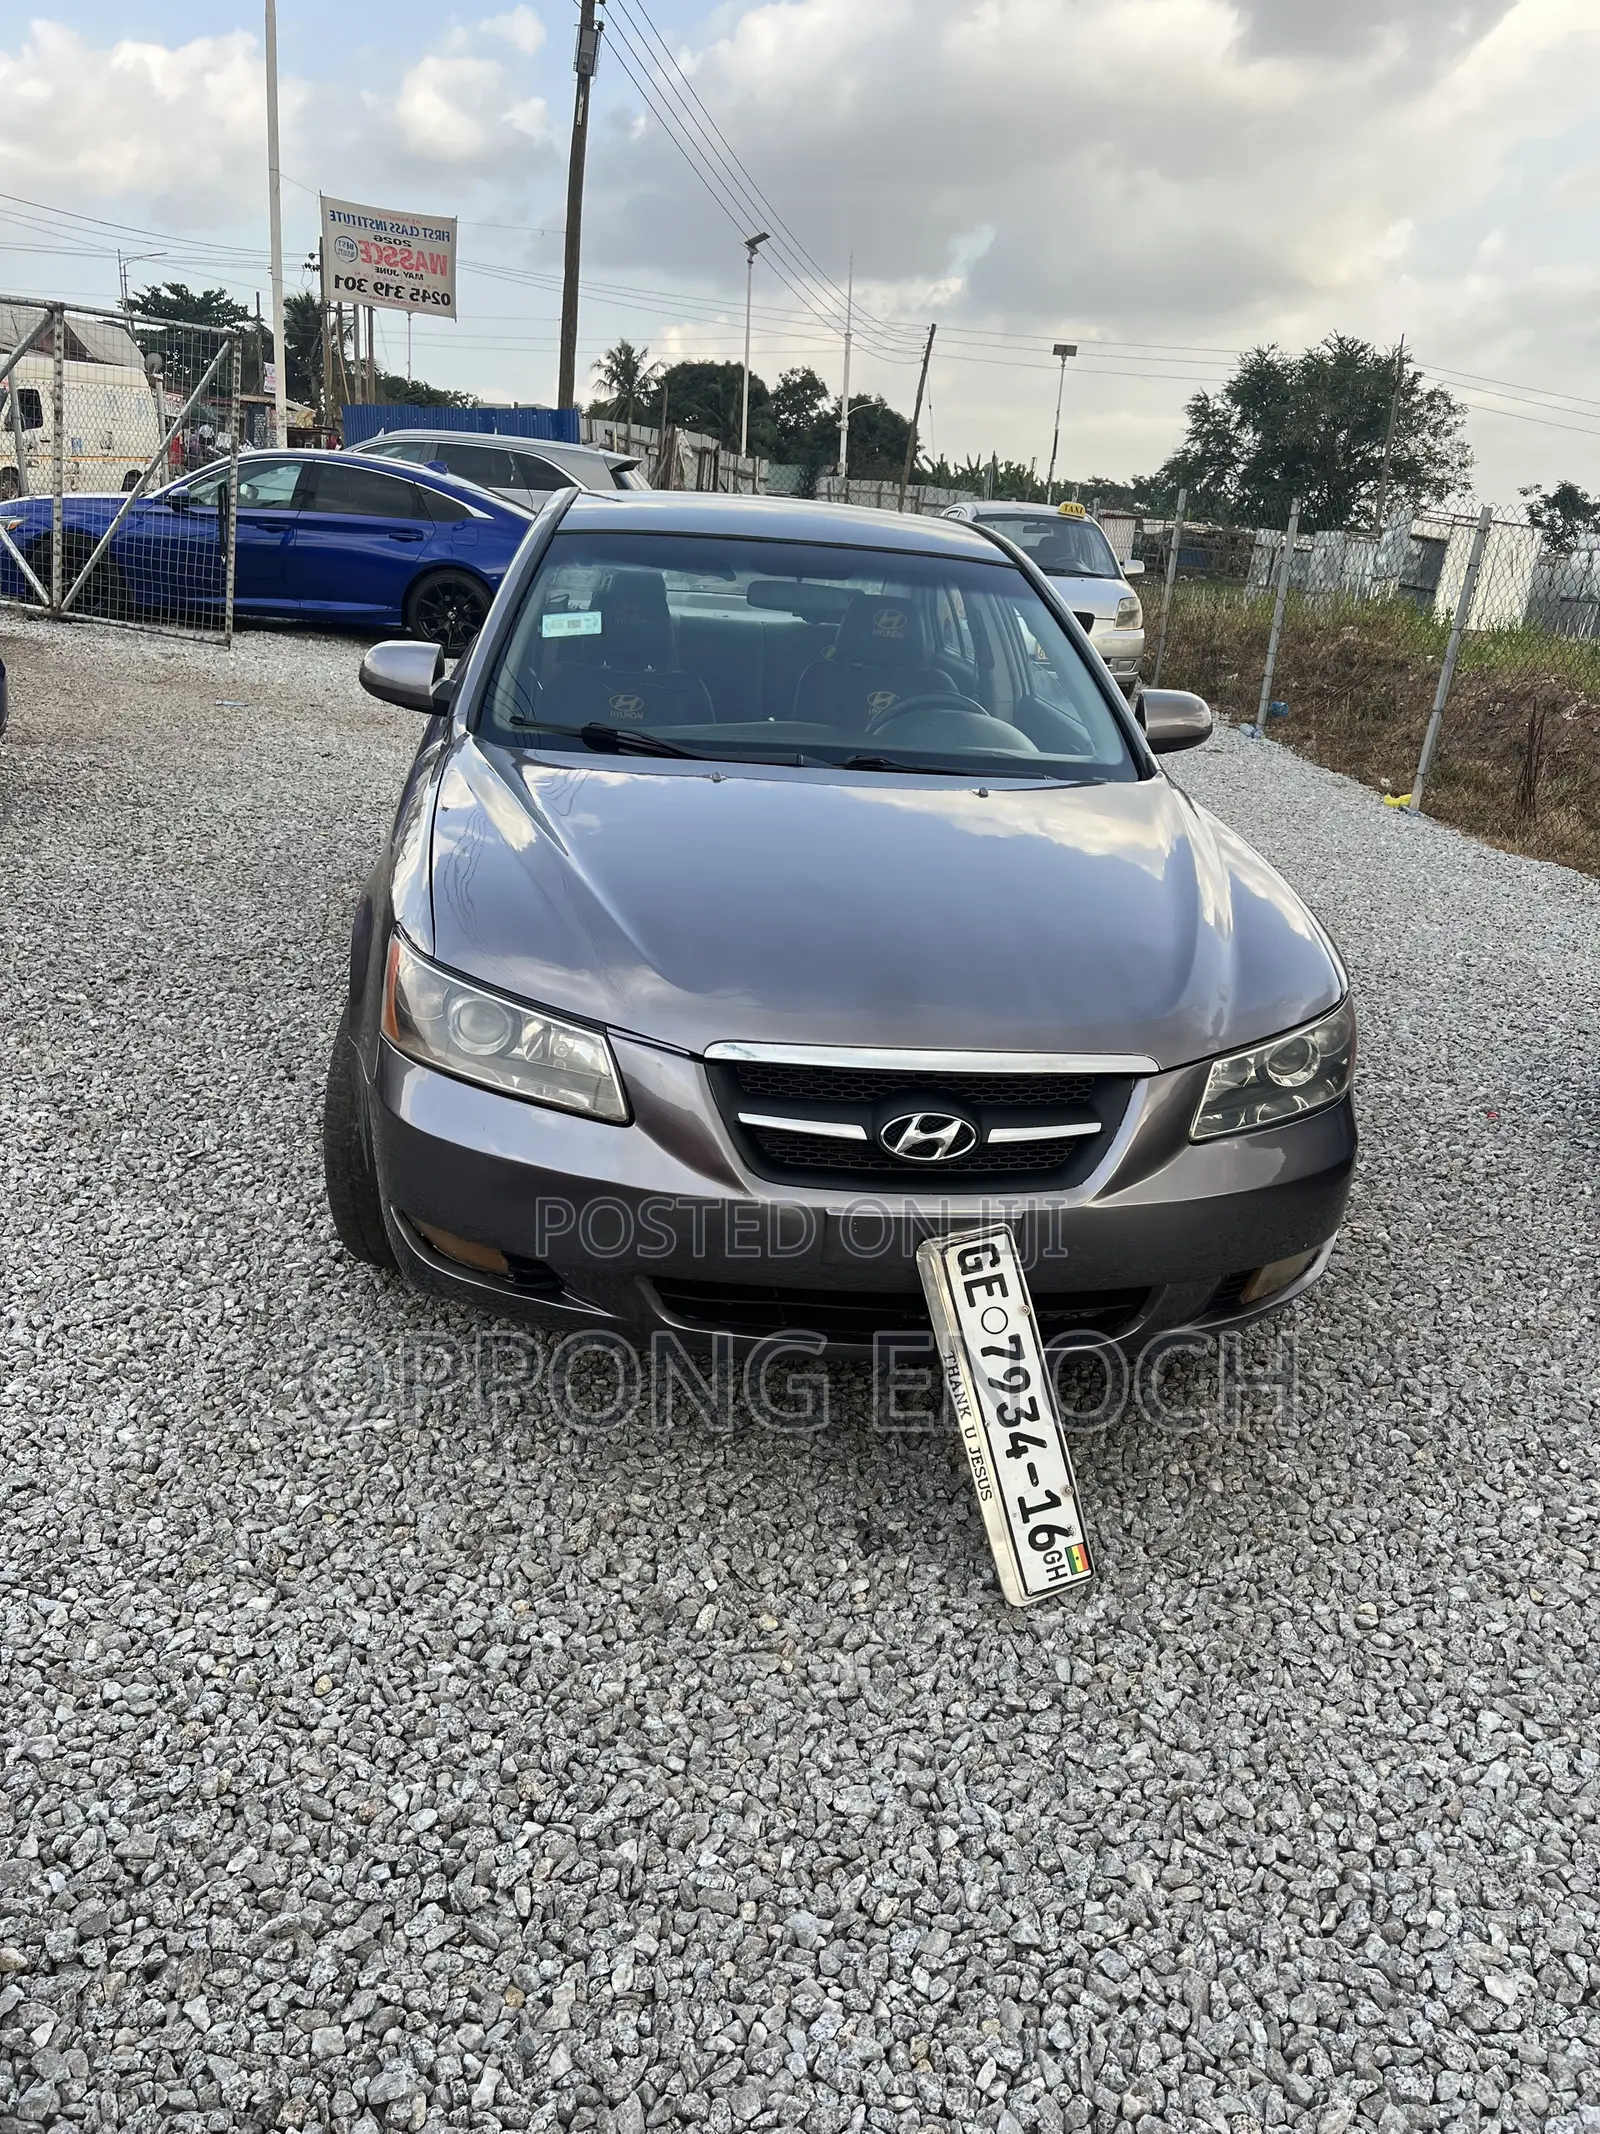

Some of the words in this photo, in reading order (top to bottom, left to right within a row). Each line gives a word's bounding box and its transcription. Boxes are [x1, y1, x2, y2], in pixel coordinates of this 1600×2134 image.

[1064, 504, 1083, 514] TAXI
[609, 710, 644, 719] HYUNDAI
[957, 1242, 1009, 1308] GE
[942, 1351, 972, 1422] THANK
[964, 1426, 977, 1439] U
[980, 1333, 1072, 1552] 7934-16
[969, 1447, 993, 1502] JESUS
[1043, 1550, 1068, 1582] GH
